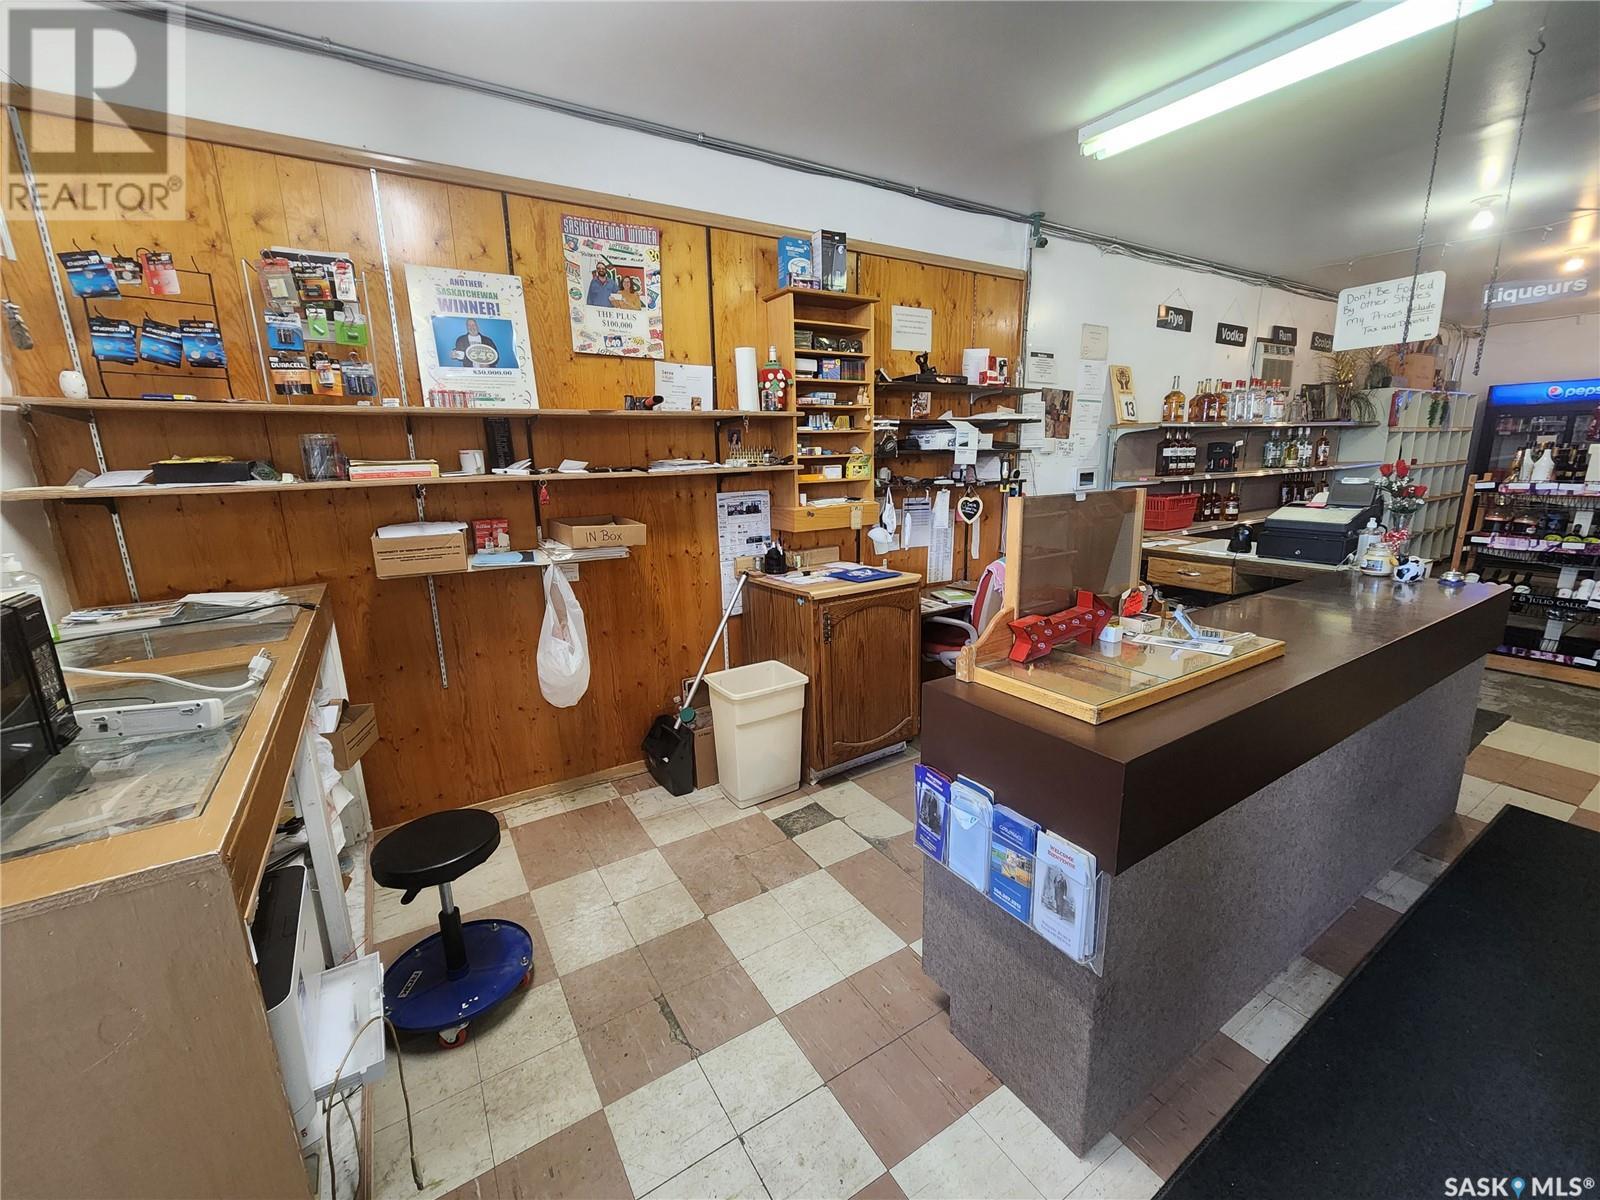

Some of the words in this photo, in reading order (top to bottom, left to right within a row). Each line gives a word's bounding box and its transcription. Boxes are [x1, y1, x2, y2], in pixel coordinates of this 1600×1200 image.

[563, 218, 625, 241] SASKATCHEWAN
[628, 227, 657, 245] WINNER
[449, 278, 484, 288] ANOTHER
[435, 287, 499, 300] SASKATCHEWAN
[1347, 289, 1372, 304] Don't
[1376, 286, 1390, 296] Be
[1397, 280, 1434, 293] Foled
[1483, 278, 1588, 305] Liqueurs
[437, 298, 501, 316] WINNER!
[1343, 305, 1355, 317] By
[597, 310, 613, 320] THE
[616, 311, 637, 321] PLUS
[1168, 311, 1184, 326] Rye
[601, 319, 633, 329] $100,000
[1363, 326, 1378, 335] Tax
[1221, 327, 1245, 343] Vodka
[1279, 329, 1293, 341] Rum
[271, 361, 305, 369] DURACELL
[1124, 401, 1136, 417] 13
[585, 532, 597, 543] IN
[601, 529, 623, 542] Box
[1528, 595, 1554, 605] JULIO
[1556, 600, 1587, 609] GALLO
